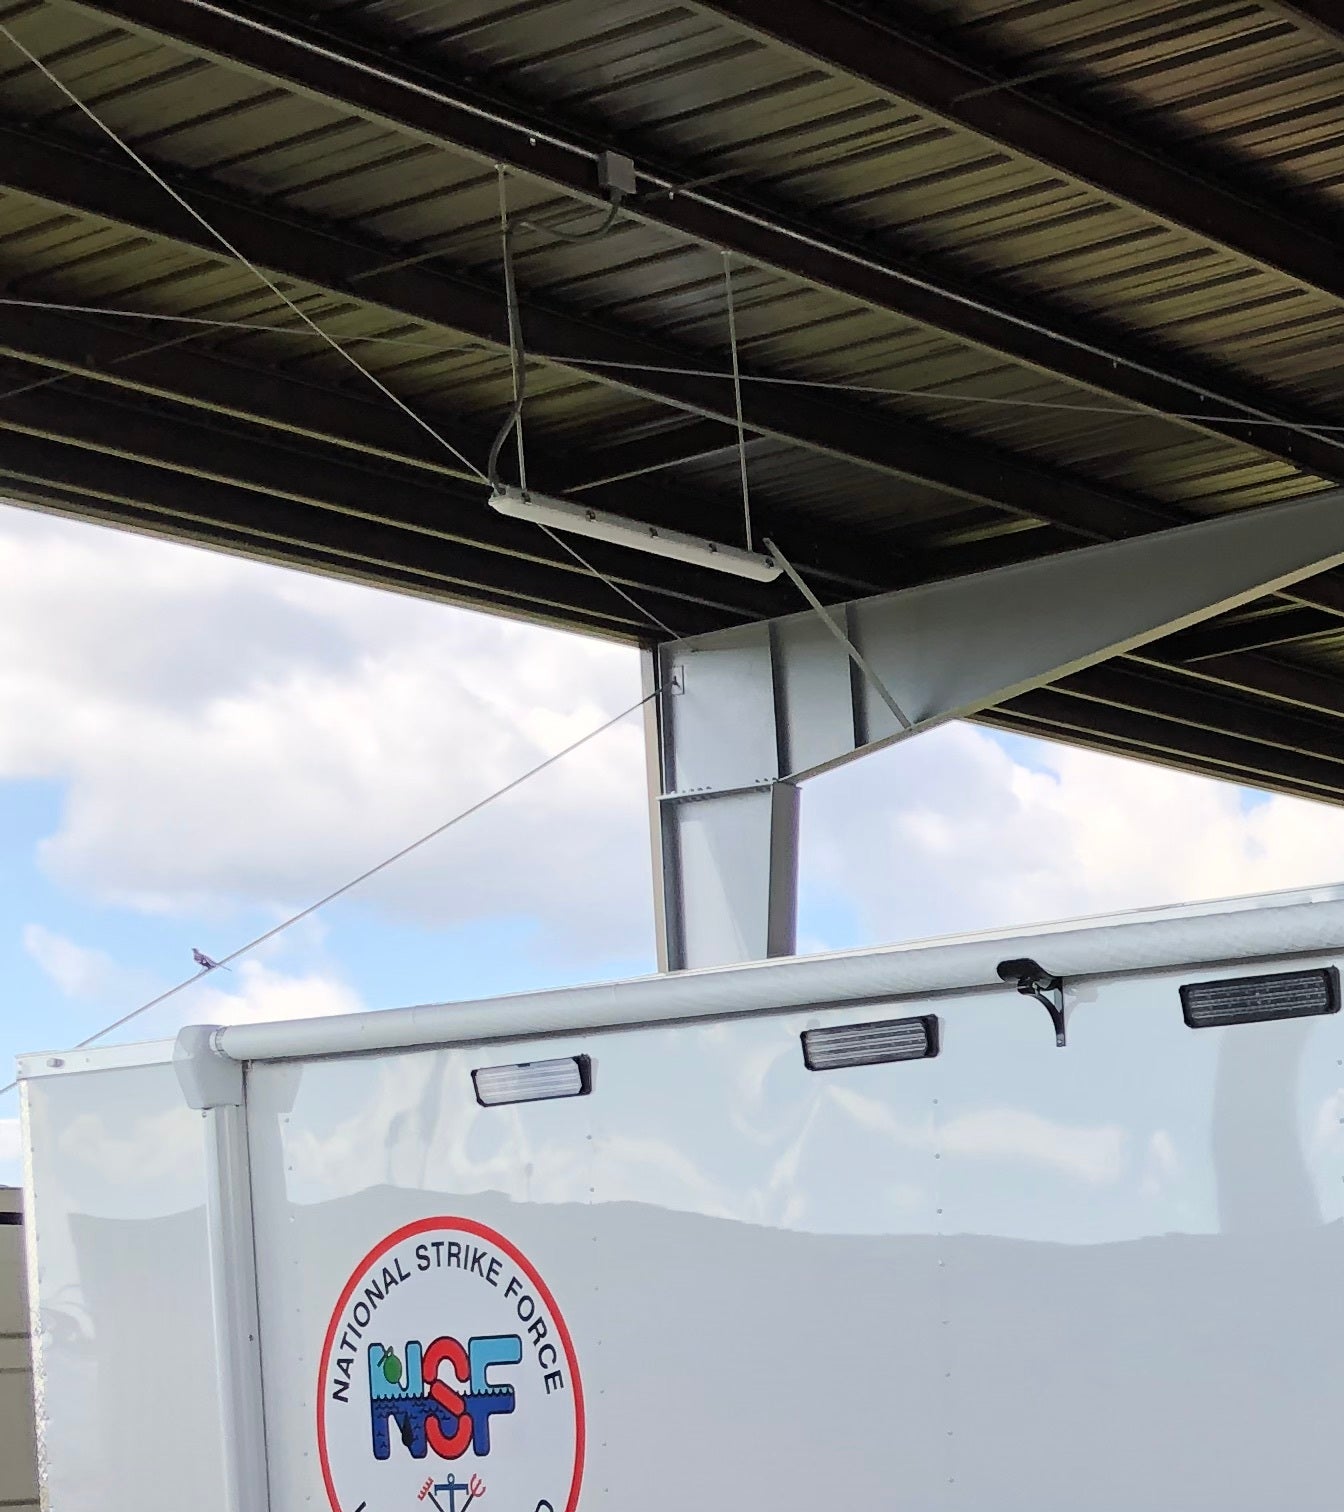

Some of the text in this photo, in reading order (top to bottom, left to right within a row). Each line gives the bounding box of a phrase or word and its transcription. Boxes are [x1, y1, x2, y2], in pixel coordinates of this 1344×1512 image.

[333, 1240, 564, 1402] NATIONAL STRIKE FORCE
[367, 1334, 522, 1460] NSF
